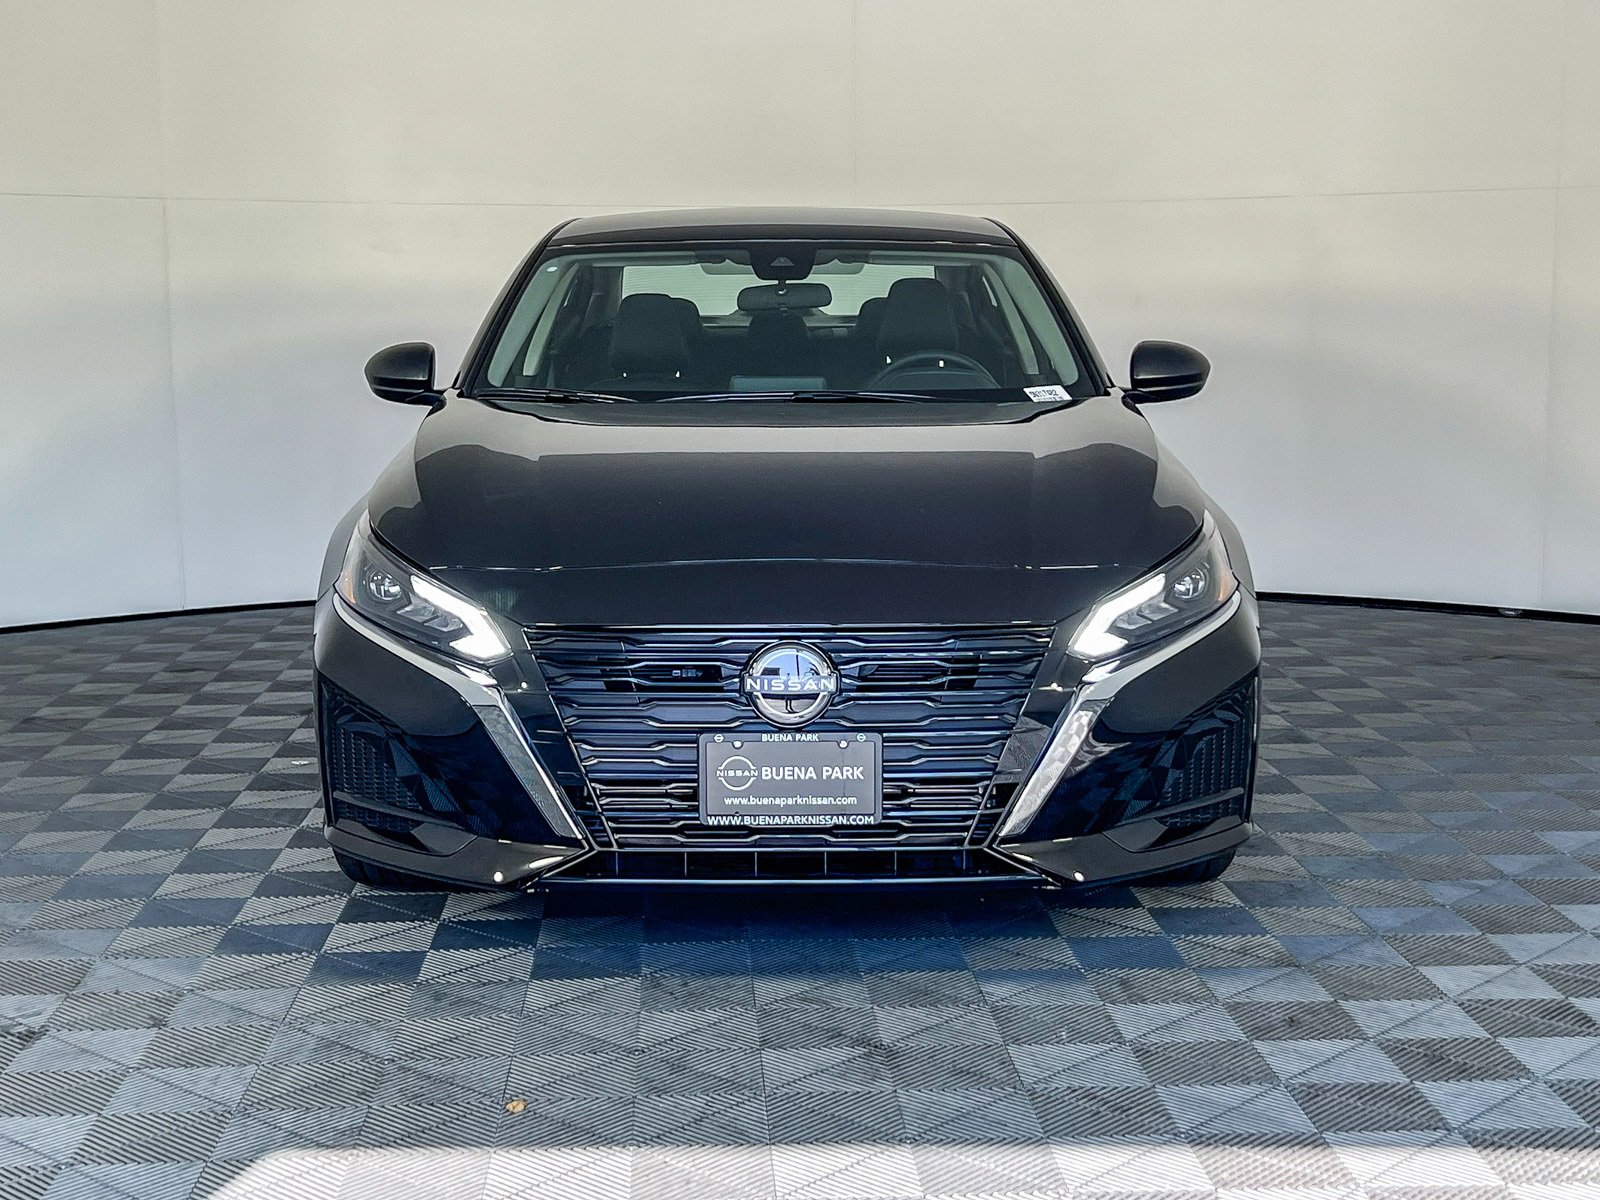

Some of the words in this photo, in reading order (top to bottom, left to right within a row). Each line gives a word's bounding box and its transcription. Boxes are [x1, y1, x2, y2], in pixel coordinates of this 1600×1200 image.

[746, 678, 834, 690] NISSAN
[761, 733, 793, 742] BUENA
[795, 733, 819, 742] PARK
[716, 769, 758, 777] NISSAN
[761, 766, 818, 780] BUENA
[822, 766, 864, 780] PARK
[723, 795, 857, 807] www.buenaparknissan.com
[706, 815, 875, 826] WWW.BUENAPARKNISSAN.COM
